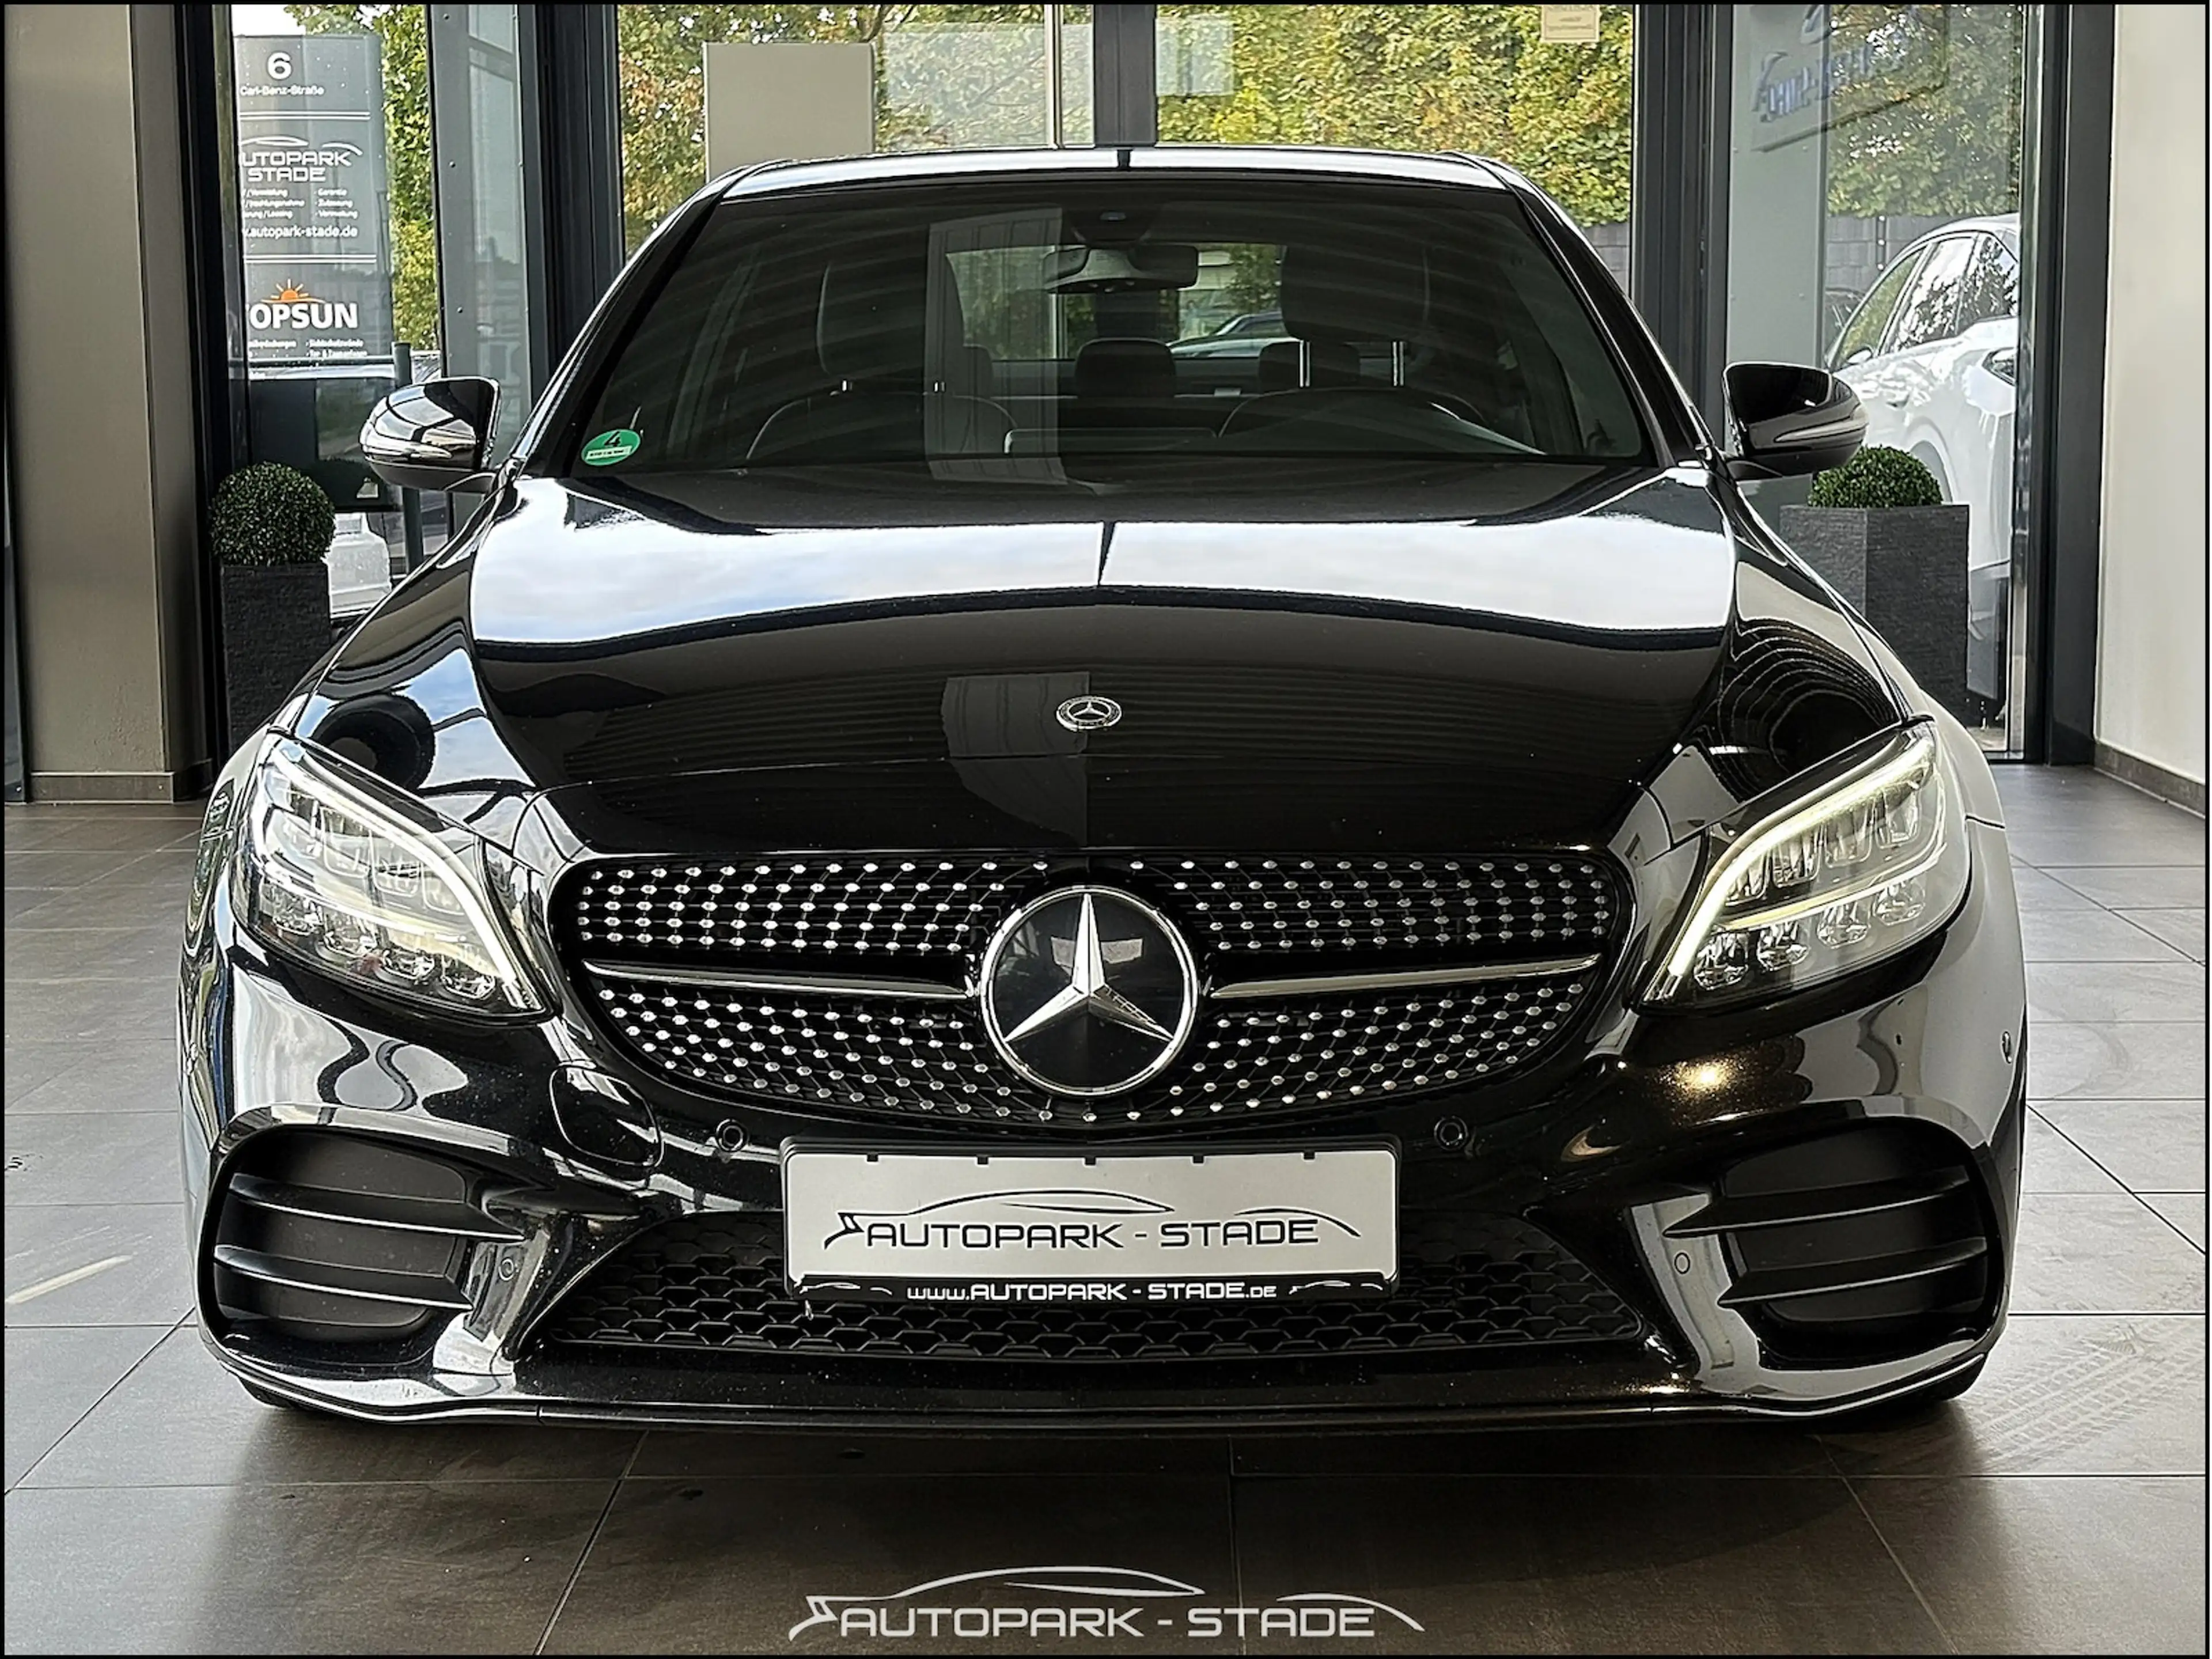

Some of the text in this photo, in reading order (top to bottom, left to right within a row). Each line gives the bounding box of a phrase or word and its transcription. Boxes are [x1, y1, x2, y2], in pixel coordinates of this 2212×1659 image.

[267, 51, 293, 79] 6
[241, 151, 352, 167] UTOPARK
[247, 167, 326, 183] STADE
[245, 302, 358, 329] OPSUN
[604, 431, 620, 447] 4
[867, 1222, 1124, 1249] AUTOPARK
[1160, 1219, 1319, 1247] STADE
